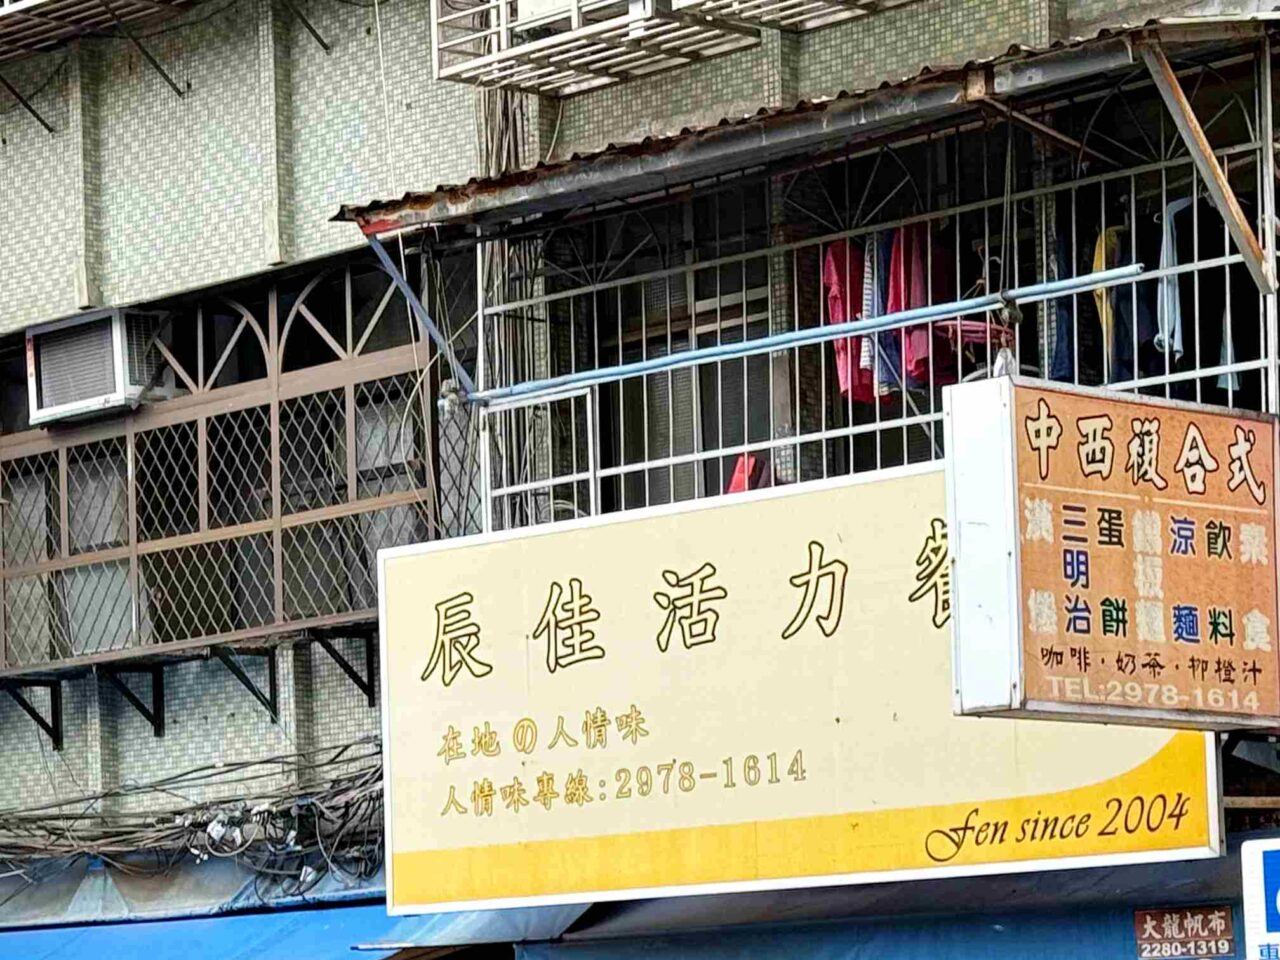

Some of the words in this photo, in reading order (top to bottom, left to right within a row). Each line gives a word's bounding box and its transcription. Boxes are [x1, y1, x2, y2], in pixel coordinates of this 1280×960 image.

[1062, 504, 1091, 635] 三明治
[1097, 507, 1128, 638] 蛋餅
[1170, 515, 1200, 644] 涼麵
[1205, 520, 1235, 647] 飲料
[1045, 676, 1260, 711] TEL:2978-1614
[1015, 808, 1091, 844] since
[1098, 791, 1191, 837] 2004
[1141, 909, 1227, 939] 大龍帆布
[1141, 940, 1230, 958] 2280-1319
